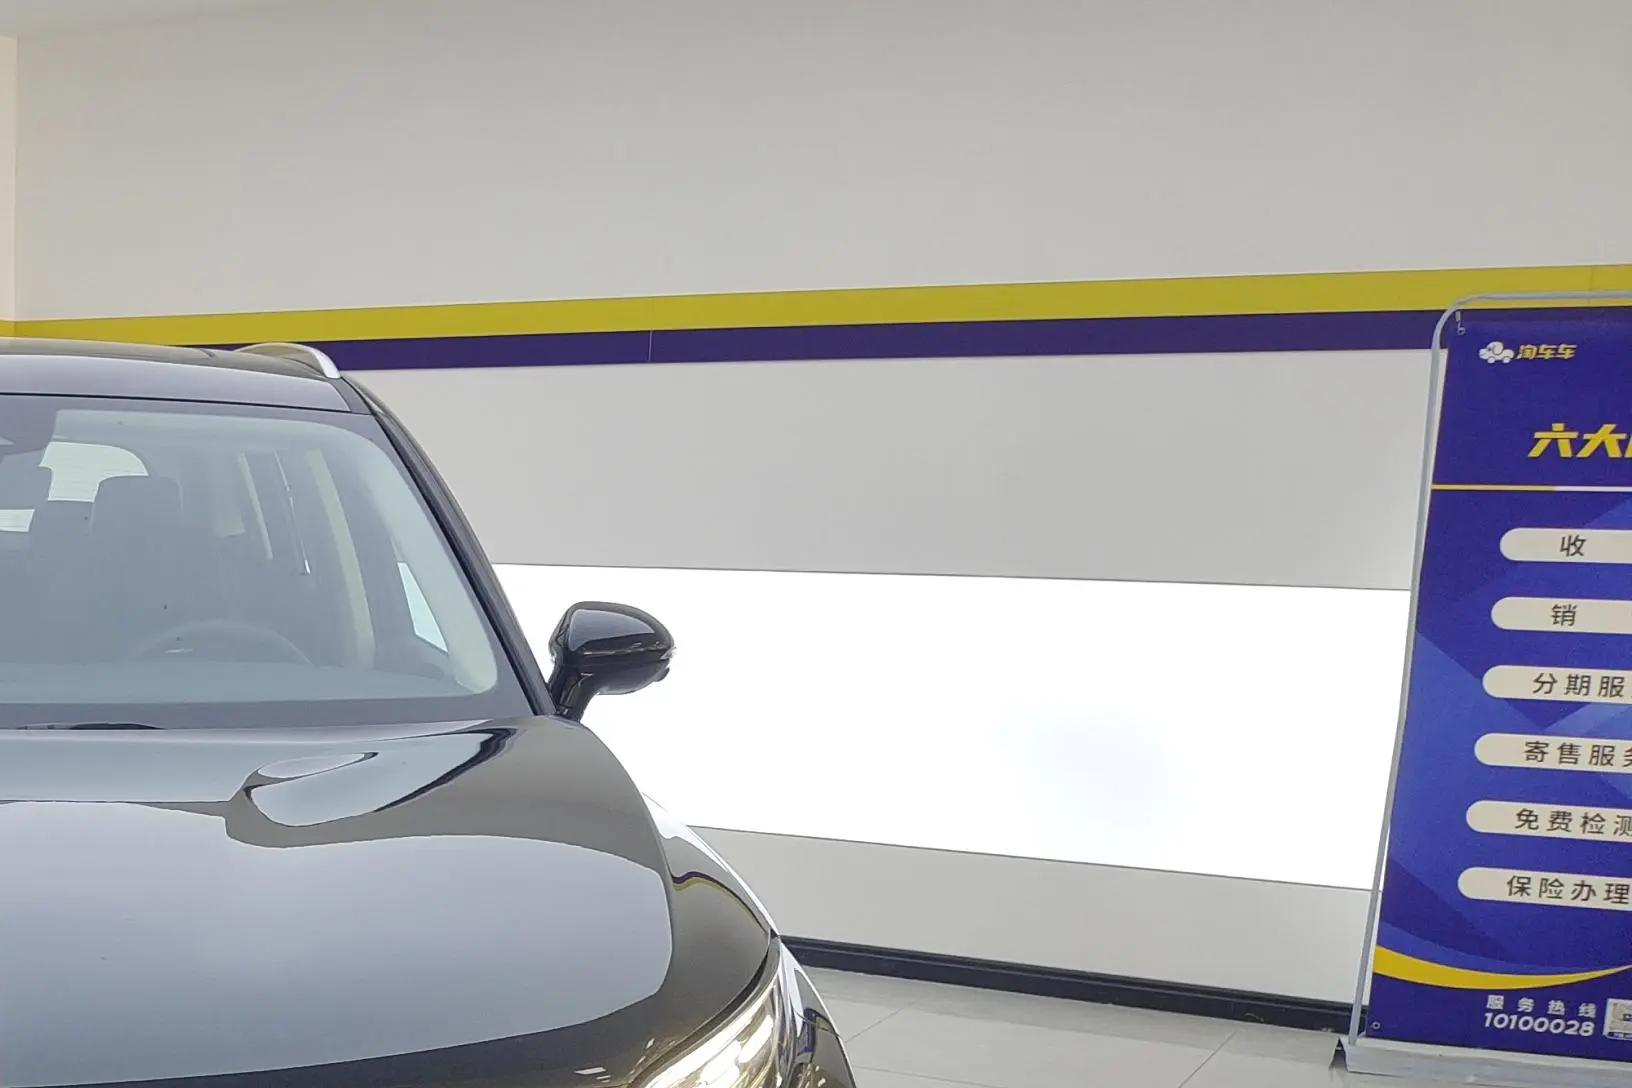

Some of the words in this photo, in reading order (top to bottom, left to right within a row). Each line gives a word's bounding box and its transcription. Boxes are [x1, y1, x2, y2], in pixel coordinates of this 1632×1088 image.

[1516, 344, 1578, 360] 淘车车
[1527, 422, 1632, 458] 六大
[1559, 534, 1587, 557] 收
[1551, 603, 1578, 627] 销
[1532, 672, 1632, 699] 分期服
[1514, 808, 1632, 837] 免费检测
[1506, 875, 1630, 905] 保险办理
[1486, 994, 1597, 1018] 服务热线
[1484, 1012, 1595, 1037] 10100028
